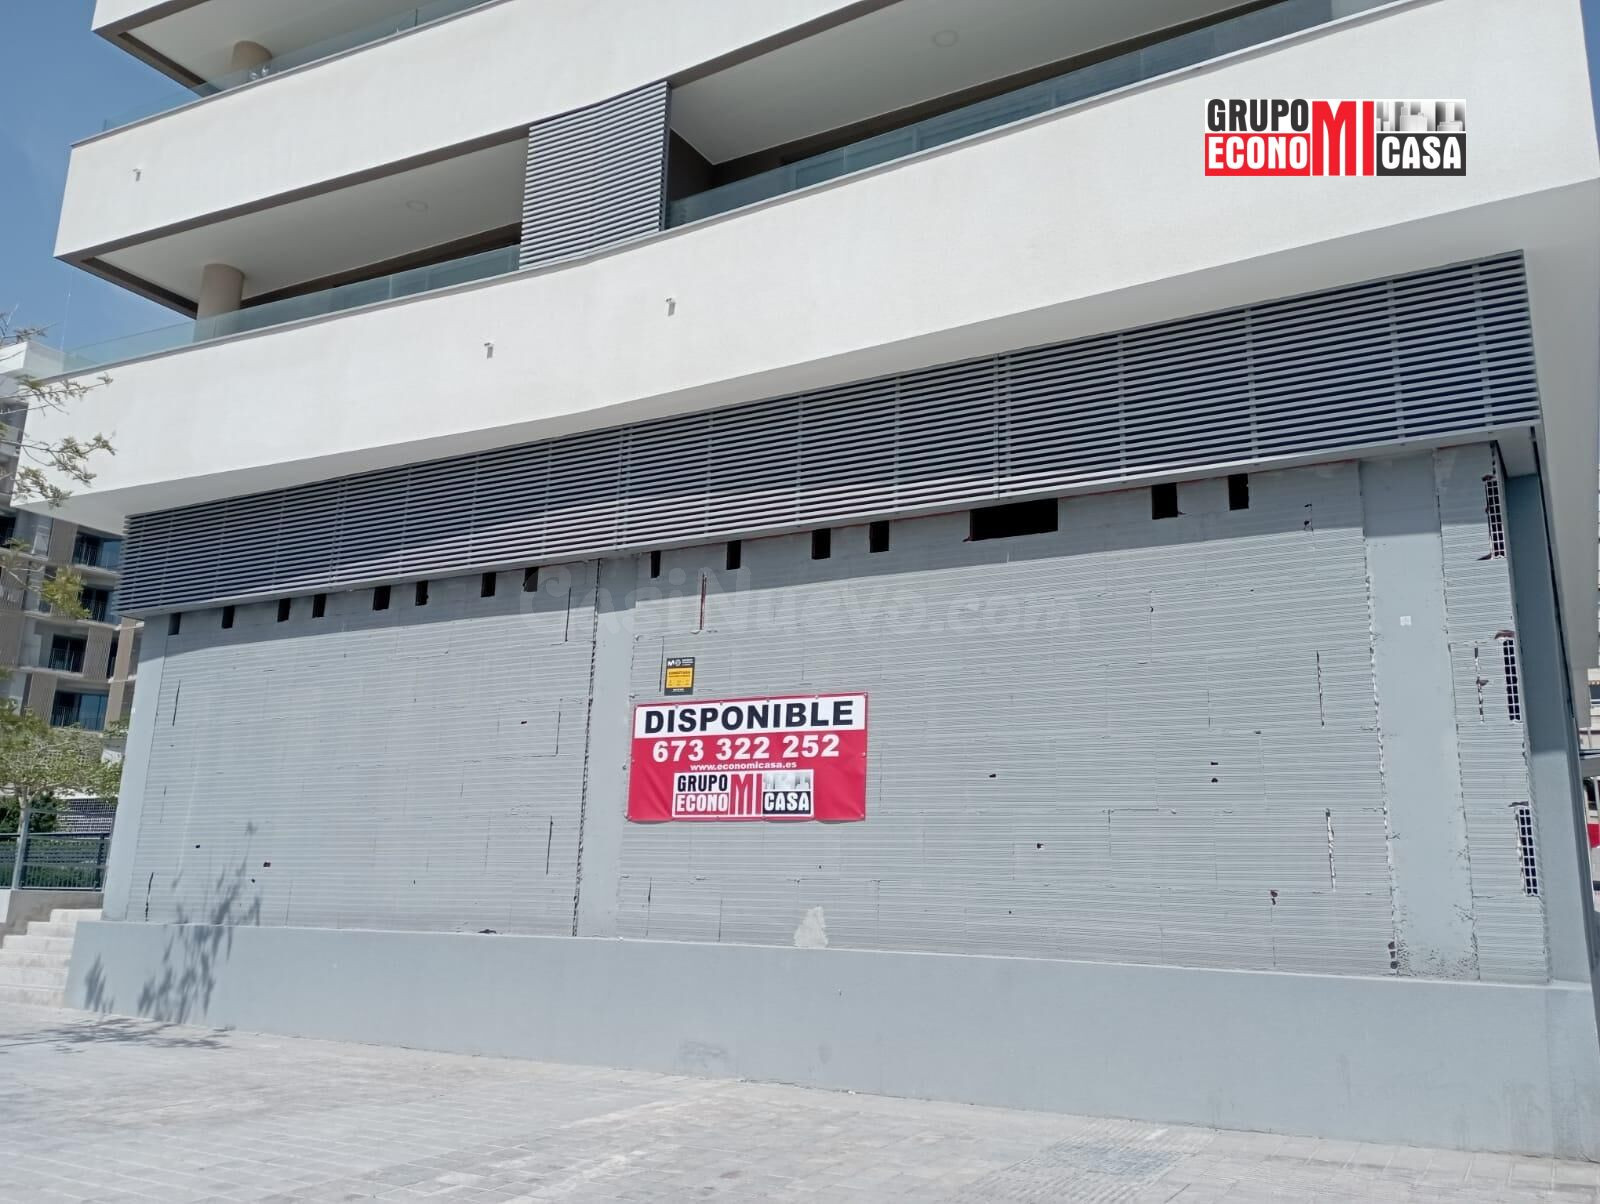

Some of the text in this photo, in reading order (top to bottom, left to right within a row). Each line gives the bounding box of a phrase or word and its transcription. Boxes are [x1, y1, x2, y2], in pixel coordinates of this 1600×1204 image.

[644, 700, 854, 734] DISPONIBLE
[653, 734, 840, 763] 673 322 252
[689, 761, 797, 772] www.economicasa.es
[677, 774, 728, 792] GRUPO
